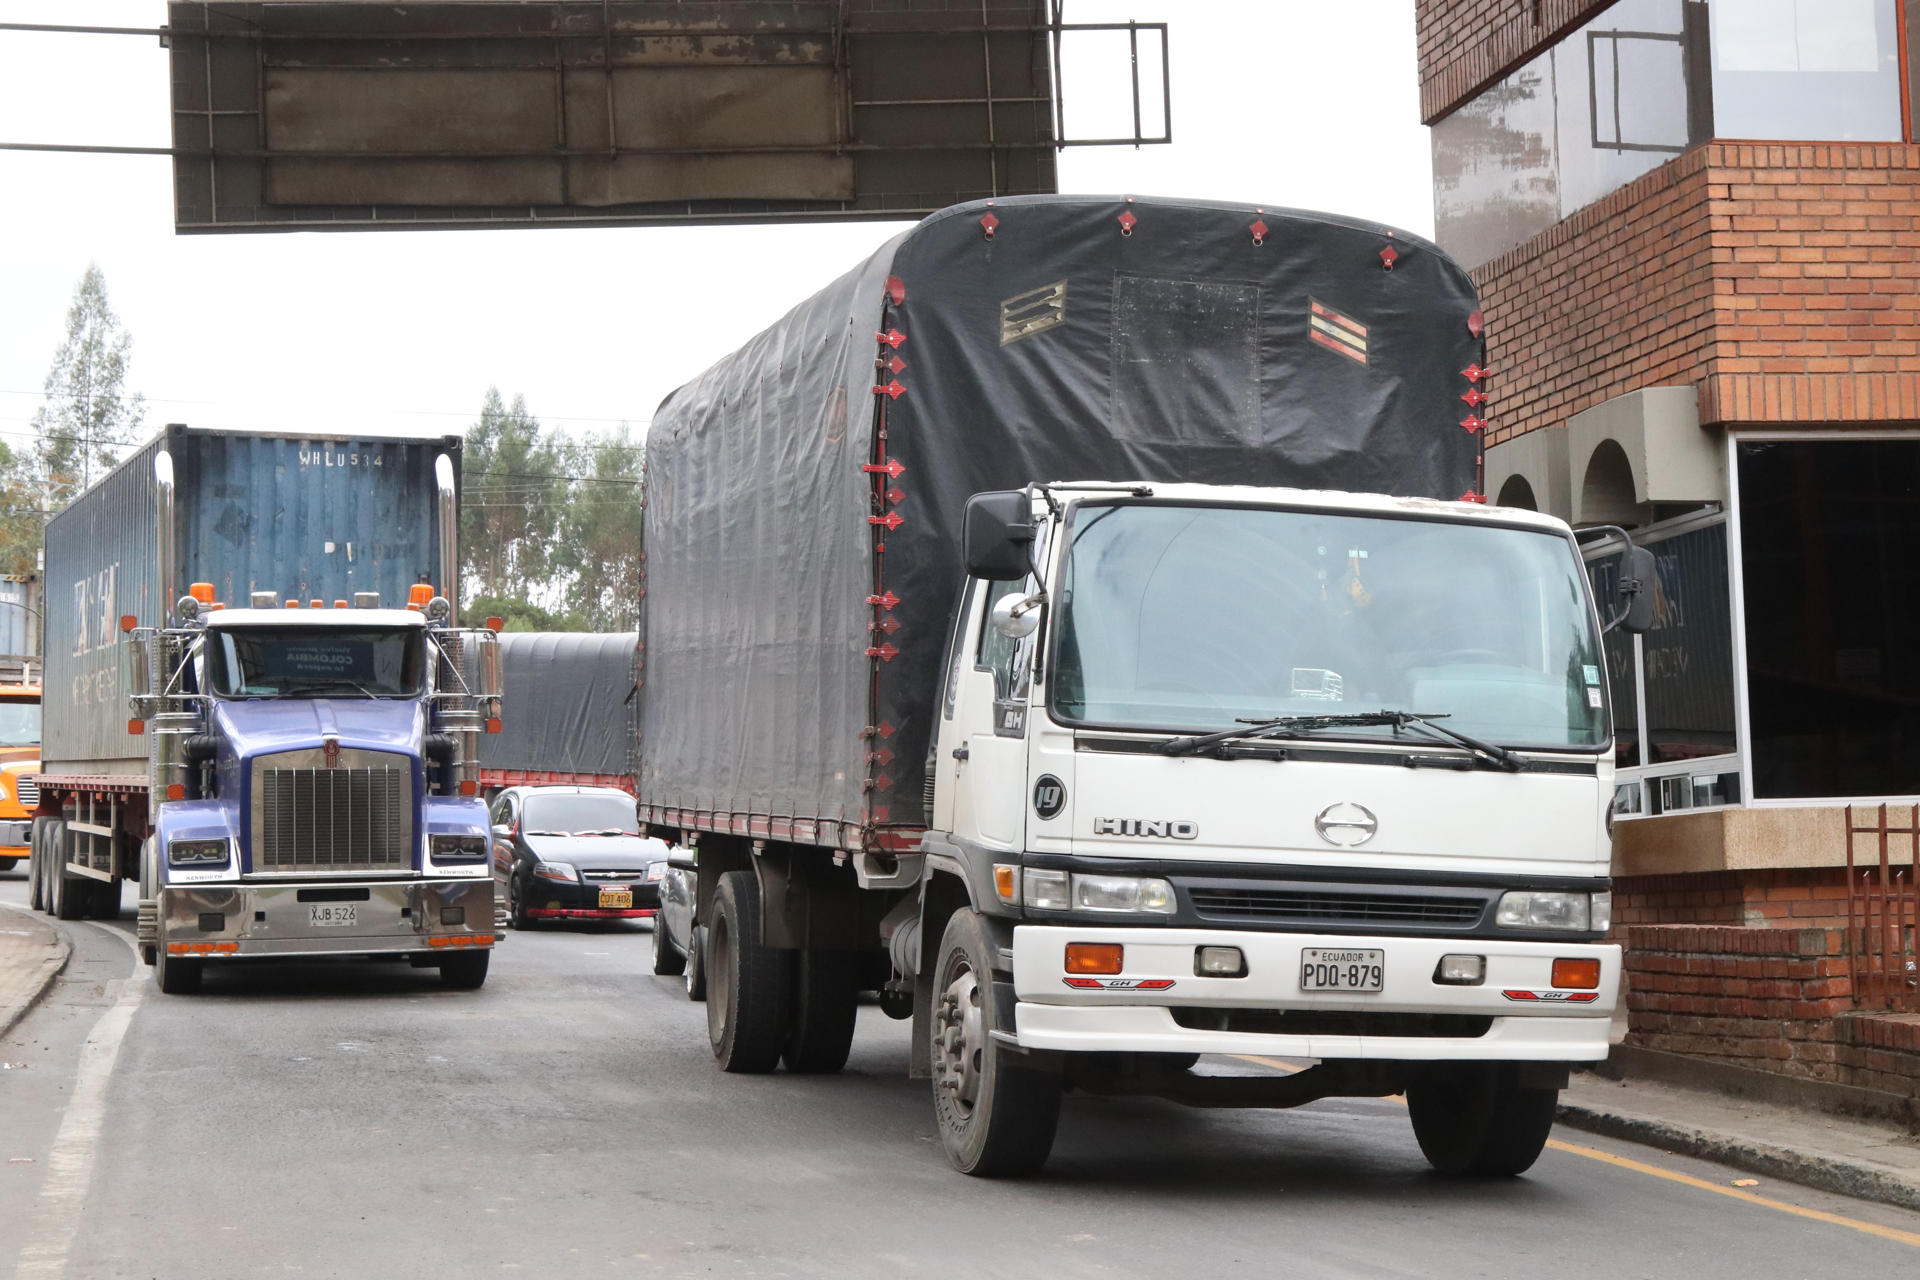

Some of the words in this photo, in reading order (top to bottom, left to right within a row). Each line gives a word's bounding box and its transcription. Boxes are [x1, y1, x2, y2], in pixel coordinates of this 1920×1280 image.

[1036, 786, 1061, 809] 19
[1094, 816, 1199, 840] HINO
[311, 908, 332, 921] XJB
[334, 907, 356, 920] 526
[1321, 952, 1364, 962] ECUADOR
[1303, 963, 1382, 988] PDQ-879
